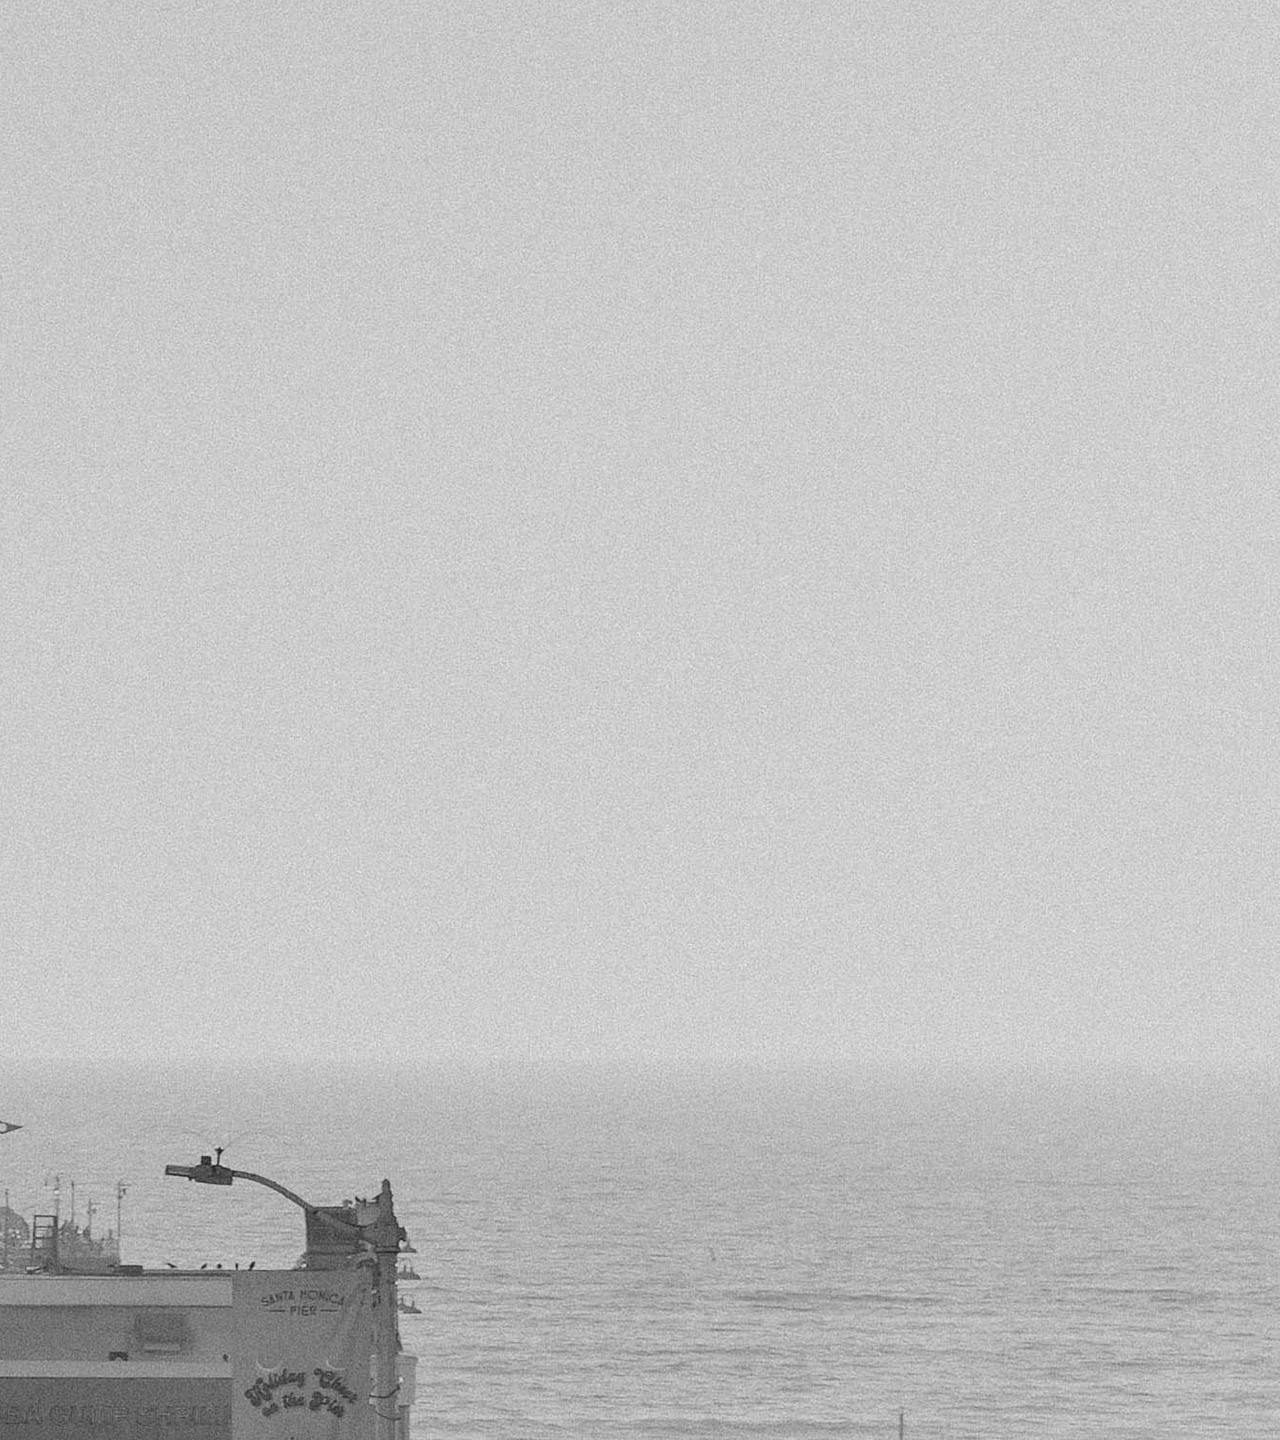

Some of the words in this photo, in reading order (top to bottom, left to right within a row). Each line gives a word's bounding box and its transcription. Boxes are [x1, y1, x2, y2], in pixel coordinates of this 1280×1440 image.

[261, 1291, 294, 1306] SANTA
[300, 1290, 345, 1306] MONICA
[290, 1306, 317, 1316] PIER
